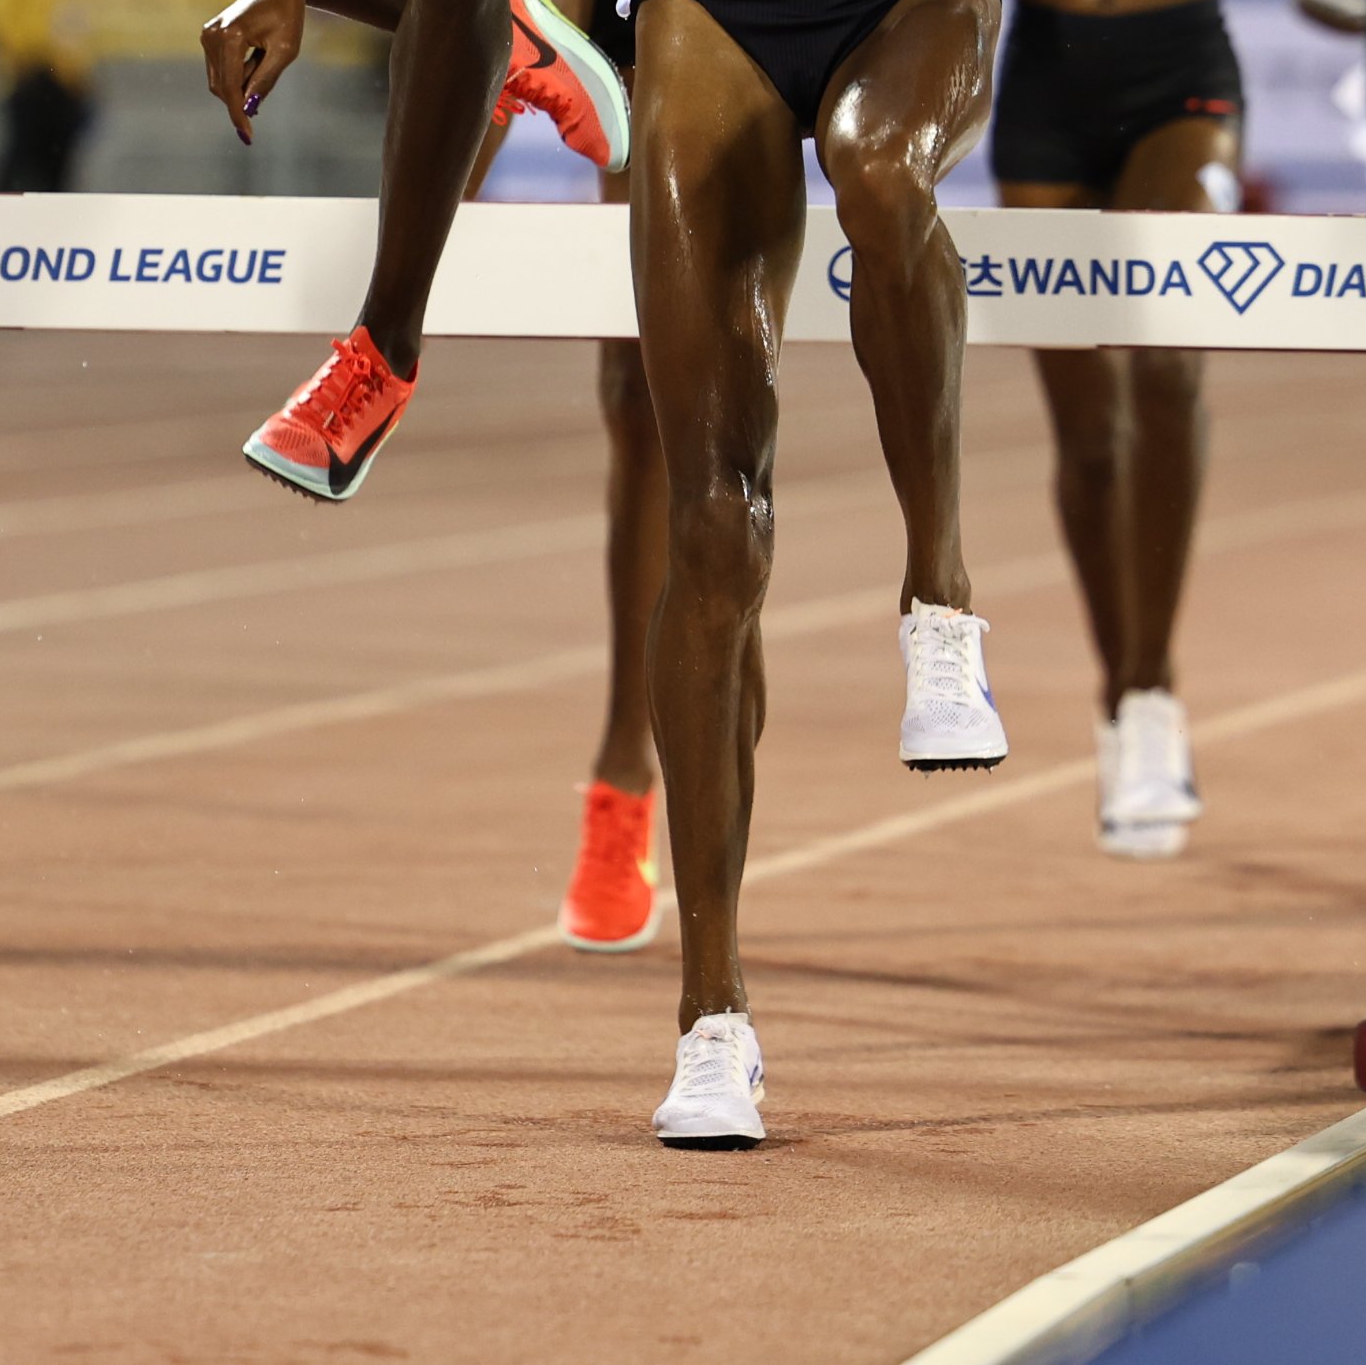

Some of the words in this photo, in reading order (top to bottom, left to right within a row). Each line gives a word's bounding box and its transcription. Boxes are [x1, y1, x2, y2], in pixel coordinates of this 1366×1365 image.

[109, 248, 287, 284] LEAGUE
[959, 254, 1003, 296] 达
[1008, 257, 1192, 297] WANDA
